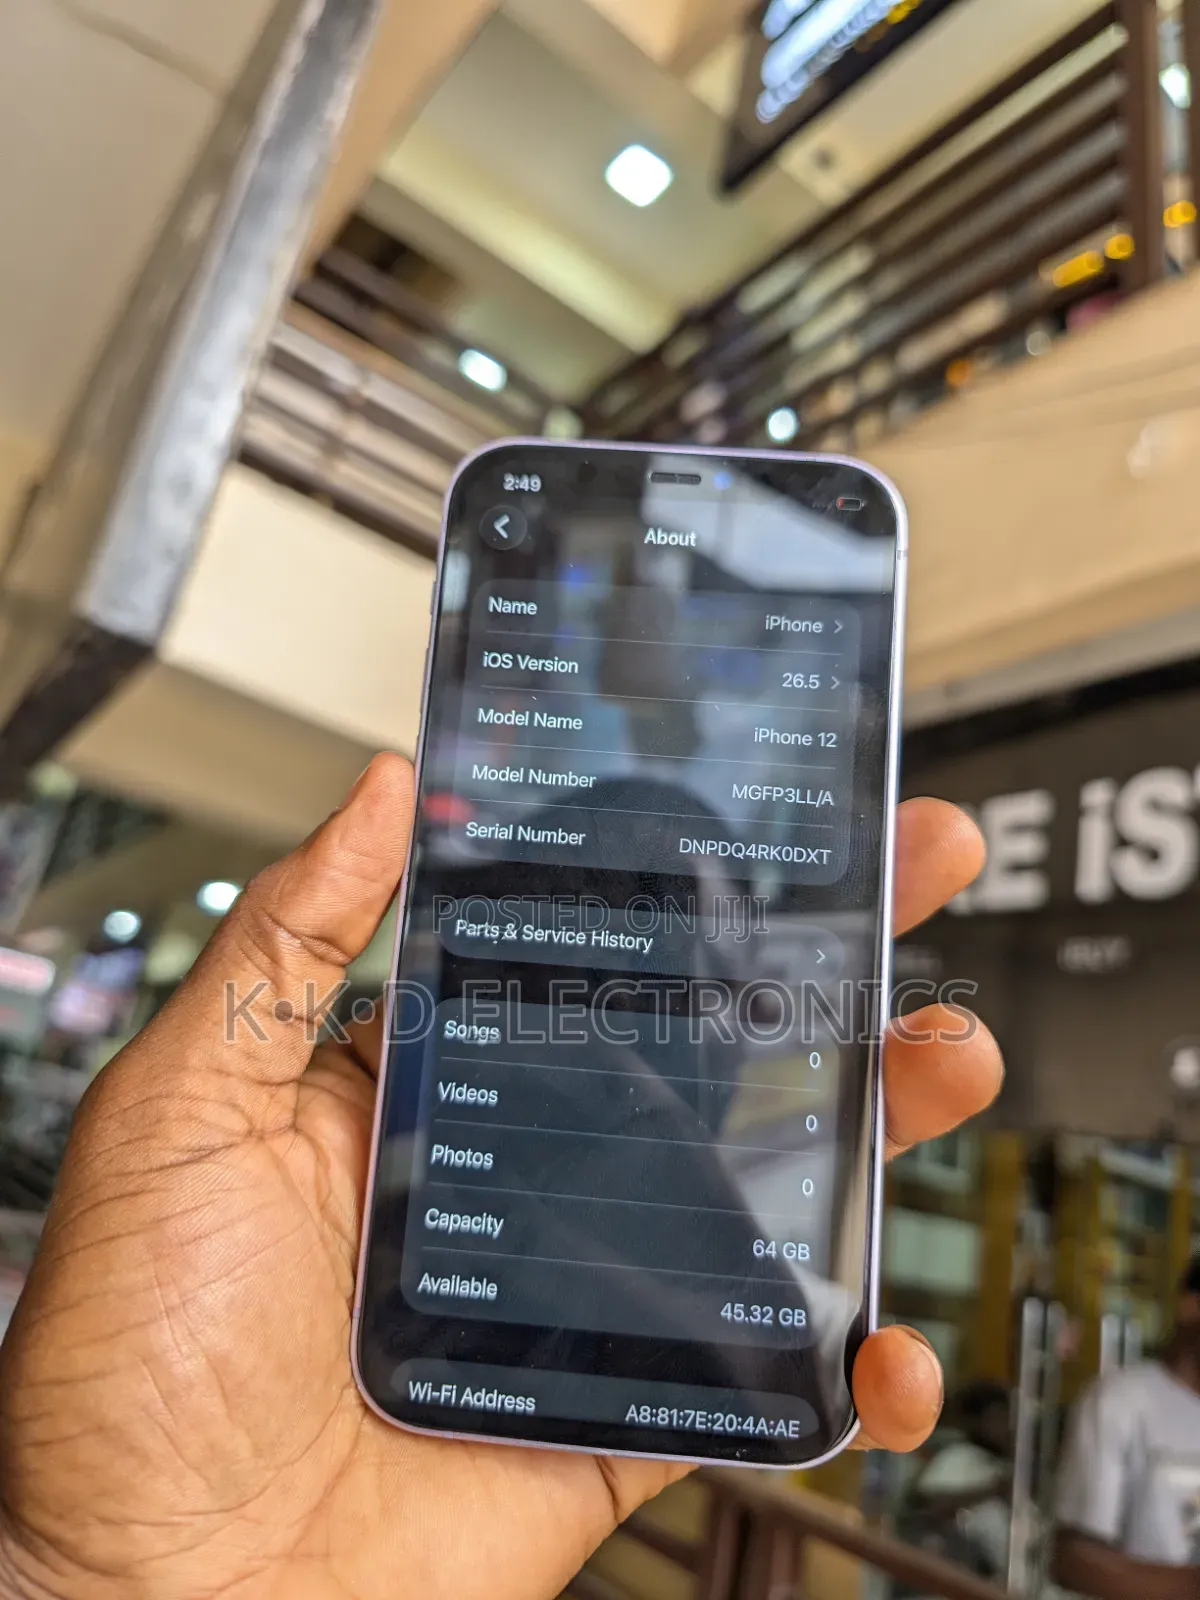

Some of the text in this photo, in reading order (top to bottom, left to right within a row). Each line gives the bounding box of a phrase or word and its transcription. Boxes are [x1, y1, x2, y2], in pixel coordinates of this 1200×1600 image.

[503, 474, 541, 493] 2:49
[644, 528, 696, 547] About
[488, 597, 537, 615] Name
[765, 615, 823, 634] iPhone
[482, 652, 579, 674] iOS Version
[782, 673, 820, 691] 26.5
[477, 708, 583, 731] Model Name
[754, 728, 837, 748] iPhone 12
[472, 764, 596, 789] Model Number
[732, 783, 834, 808] MGFP3LL/A
[466, 822, 586, 846] Serial Number
[679, 838, 832, 865] DNPDQ4RK0DXT
[455, 919, 653, 953] Parts & Service History
[444, 1020, 500, 1045] Songs
[808, 1052, 821, 1070] 0
[438, 1081, 498, 1105] Videos
[805, 1115, 818, 1133] 0
[431, 1145, 494, 1169] Photos
[801, 1178, 814, 1197] 0
[425, 1208, 504, 1240] Capacity
[752, 1239, 810, 1261] 64 GB
[417, 1273, 498, 1301] Available
[720, 1302, 807, 1327] 45.32 GB
[408, 1381, 537, 1414] Wi-Fi Address
[625, 1404, 800, 1438] A8:81:7E:20:4A:AE
